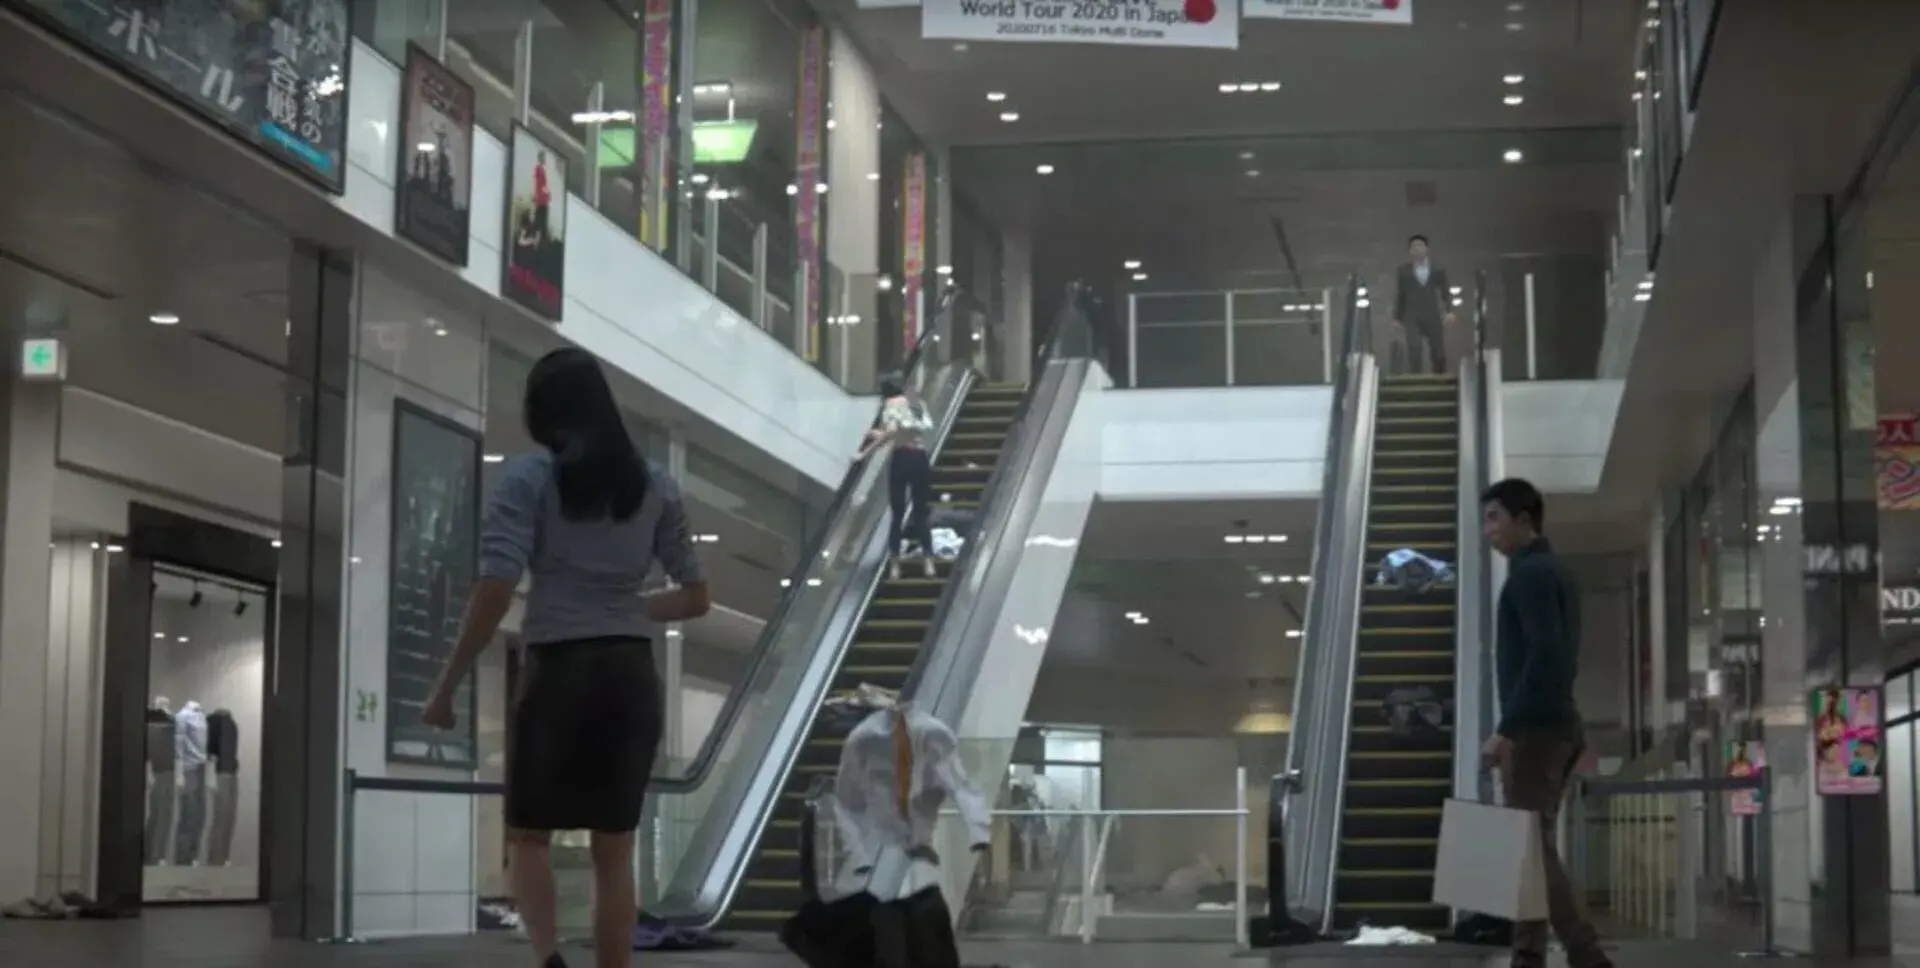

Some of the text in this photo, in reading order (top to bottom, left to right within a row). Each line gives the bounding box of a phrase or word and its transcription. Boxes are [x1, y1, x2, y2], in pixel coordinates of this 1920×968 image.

[959, 0, 1015, 18] World
[1021, 2, 1066, 19] Tour
[1072, 2, 1117, 21] 2020
[1124, 2, 1141, 22] in
